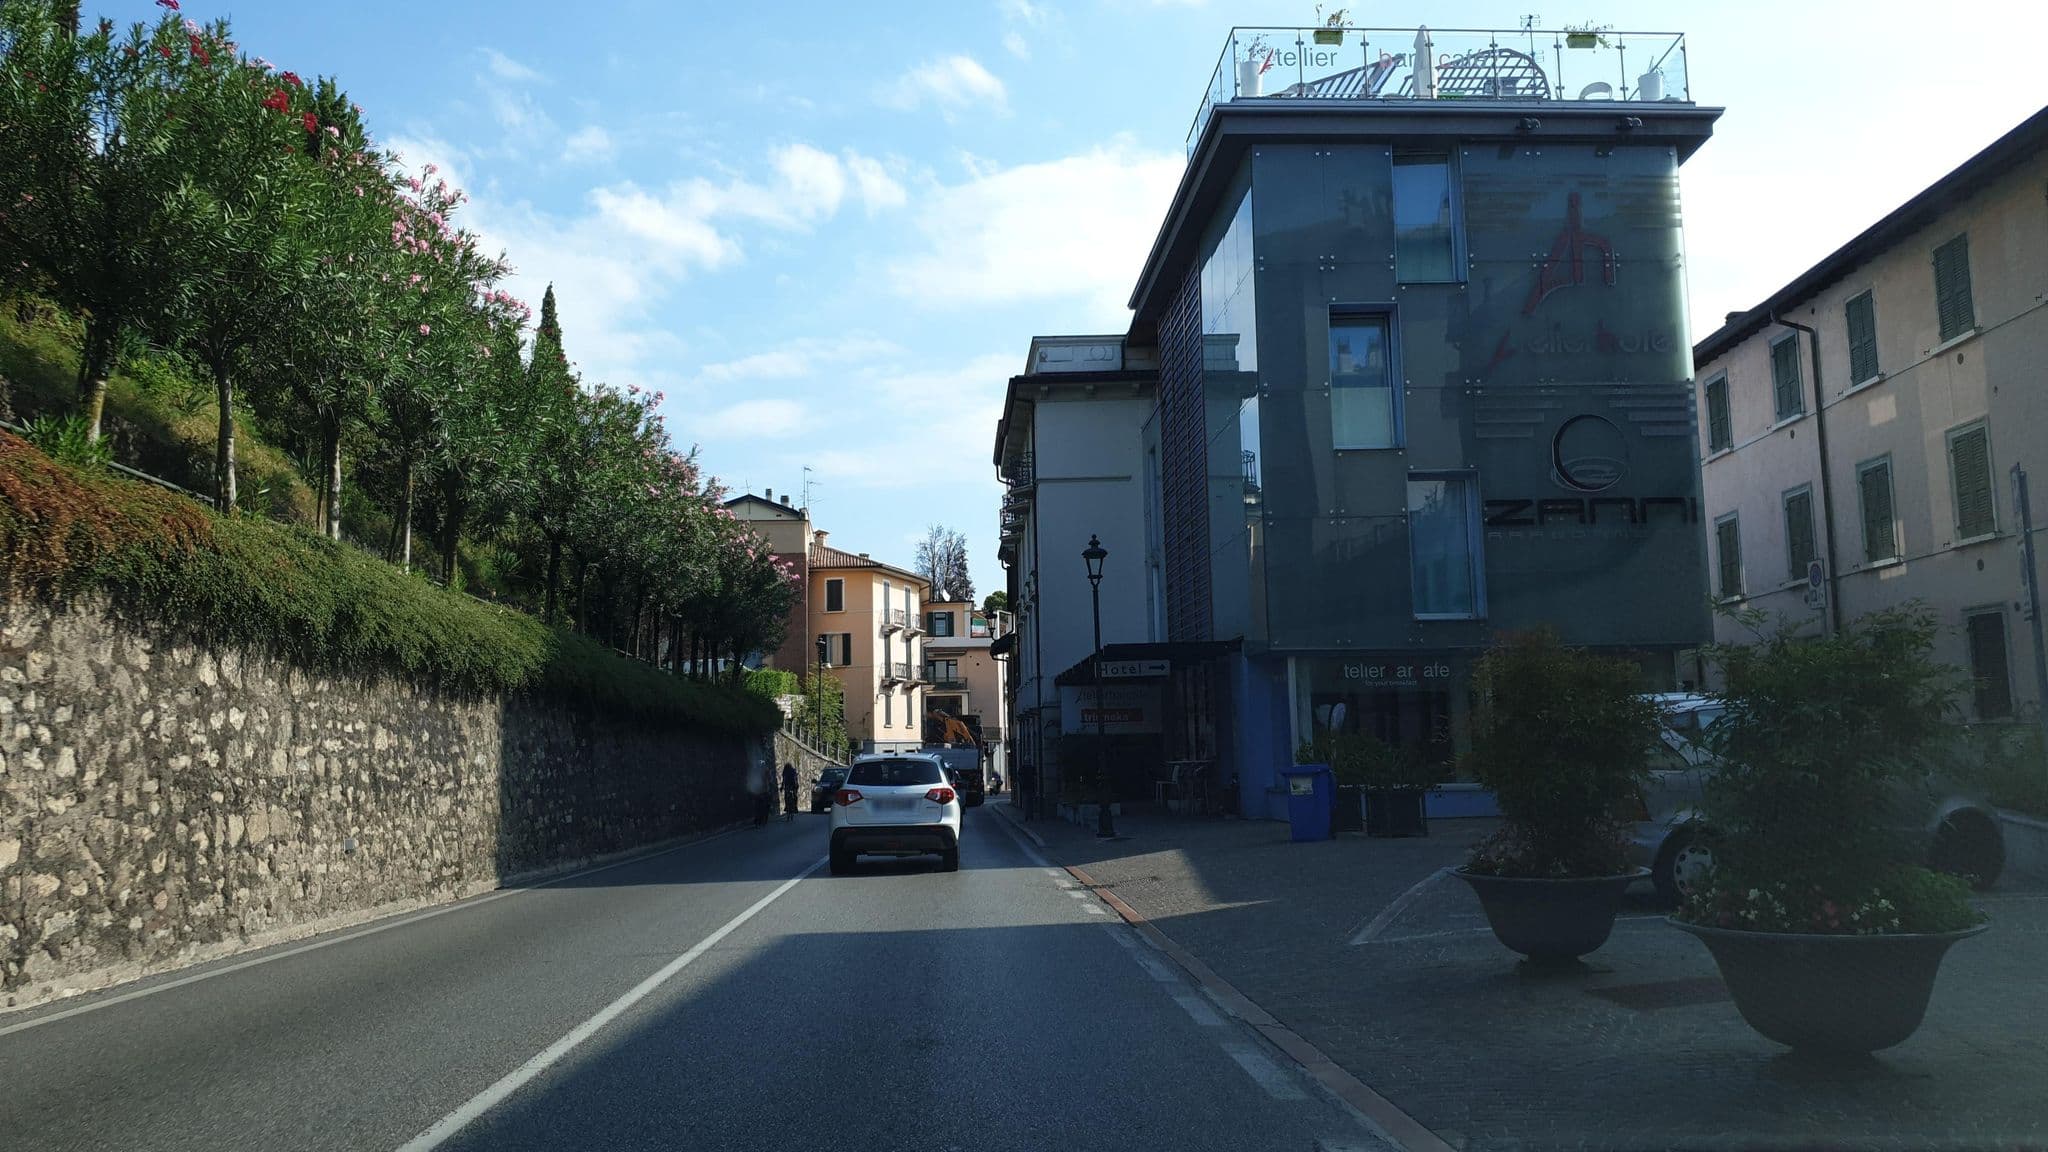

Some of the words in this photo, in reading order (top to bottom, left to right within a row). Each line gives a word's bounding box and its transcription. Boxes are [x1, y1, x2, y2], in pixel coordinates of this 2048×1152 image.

[1099, 663, 1142, 675] Hotel
[1341, 663, 1386, 680] telier
[1392, 665, 1415, 679] ar
[1420, 661, 1450, 679] afe
